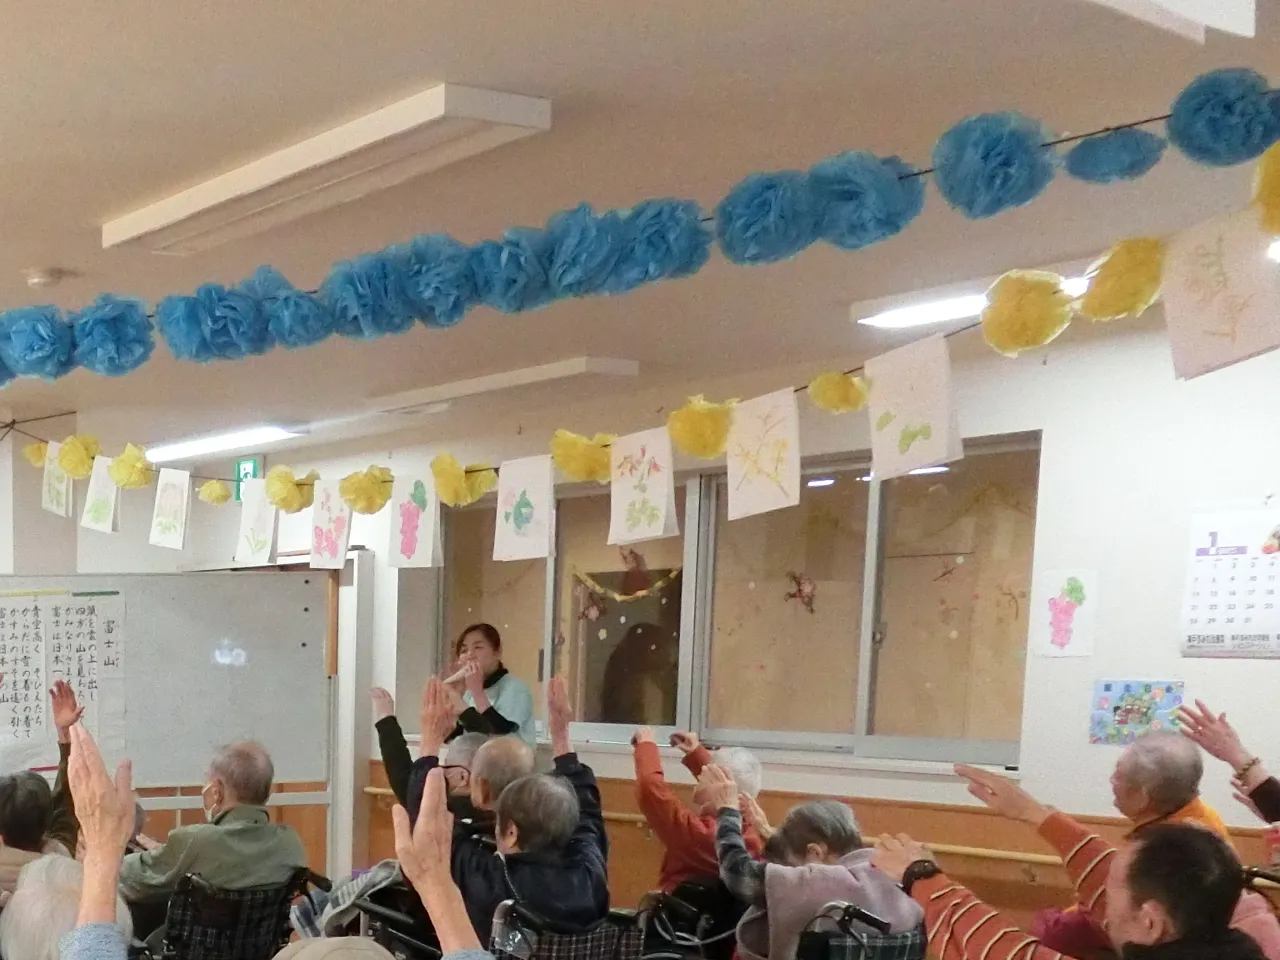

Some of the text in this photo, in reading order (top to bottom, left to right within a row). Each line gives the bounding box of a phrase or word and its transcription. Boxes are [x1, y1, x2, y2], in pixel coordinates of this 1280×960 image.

[75, 607, 87, 725] 四方の山を見おろて
[103, 619, 116, 666] 富士山
